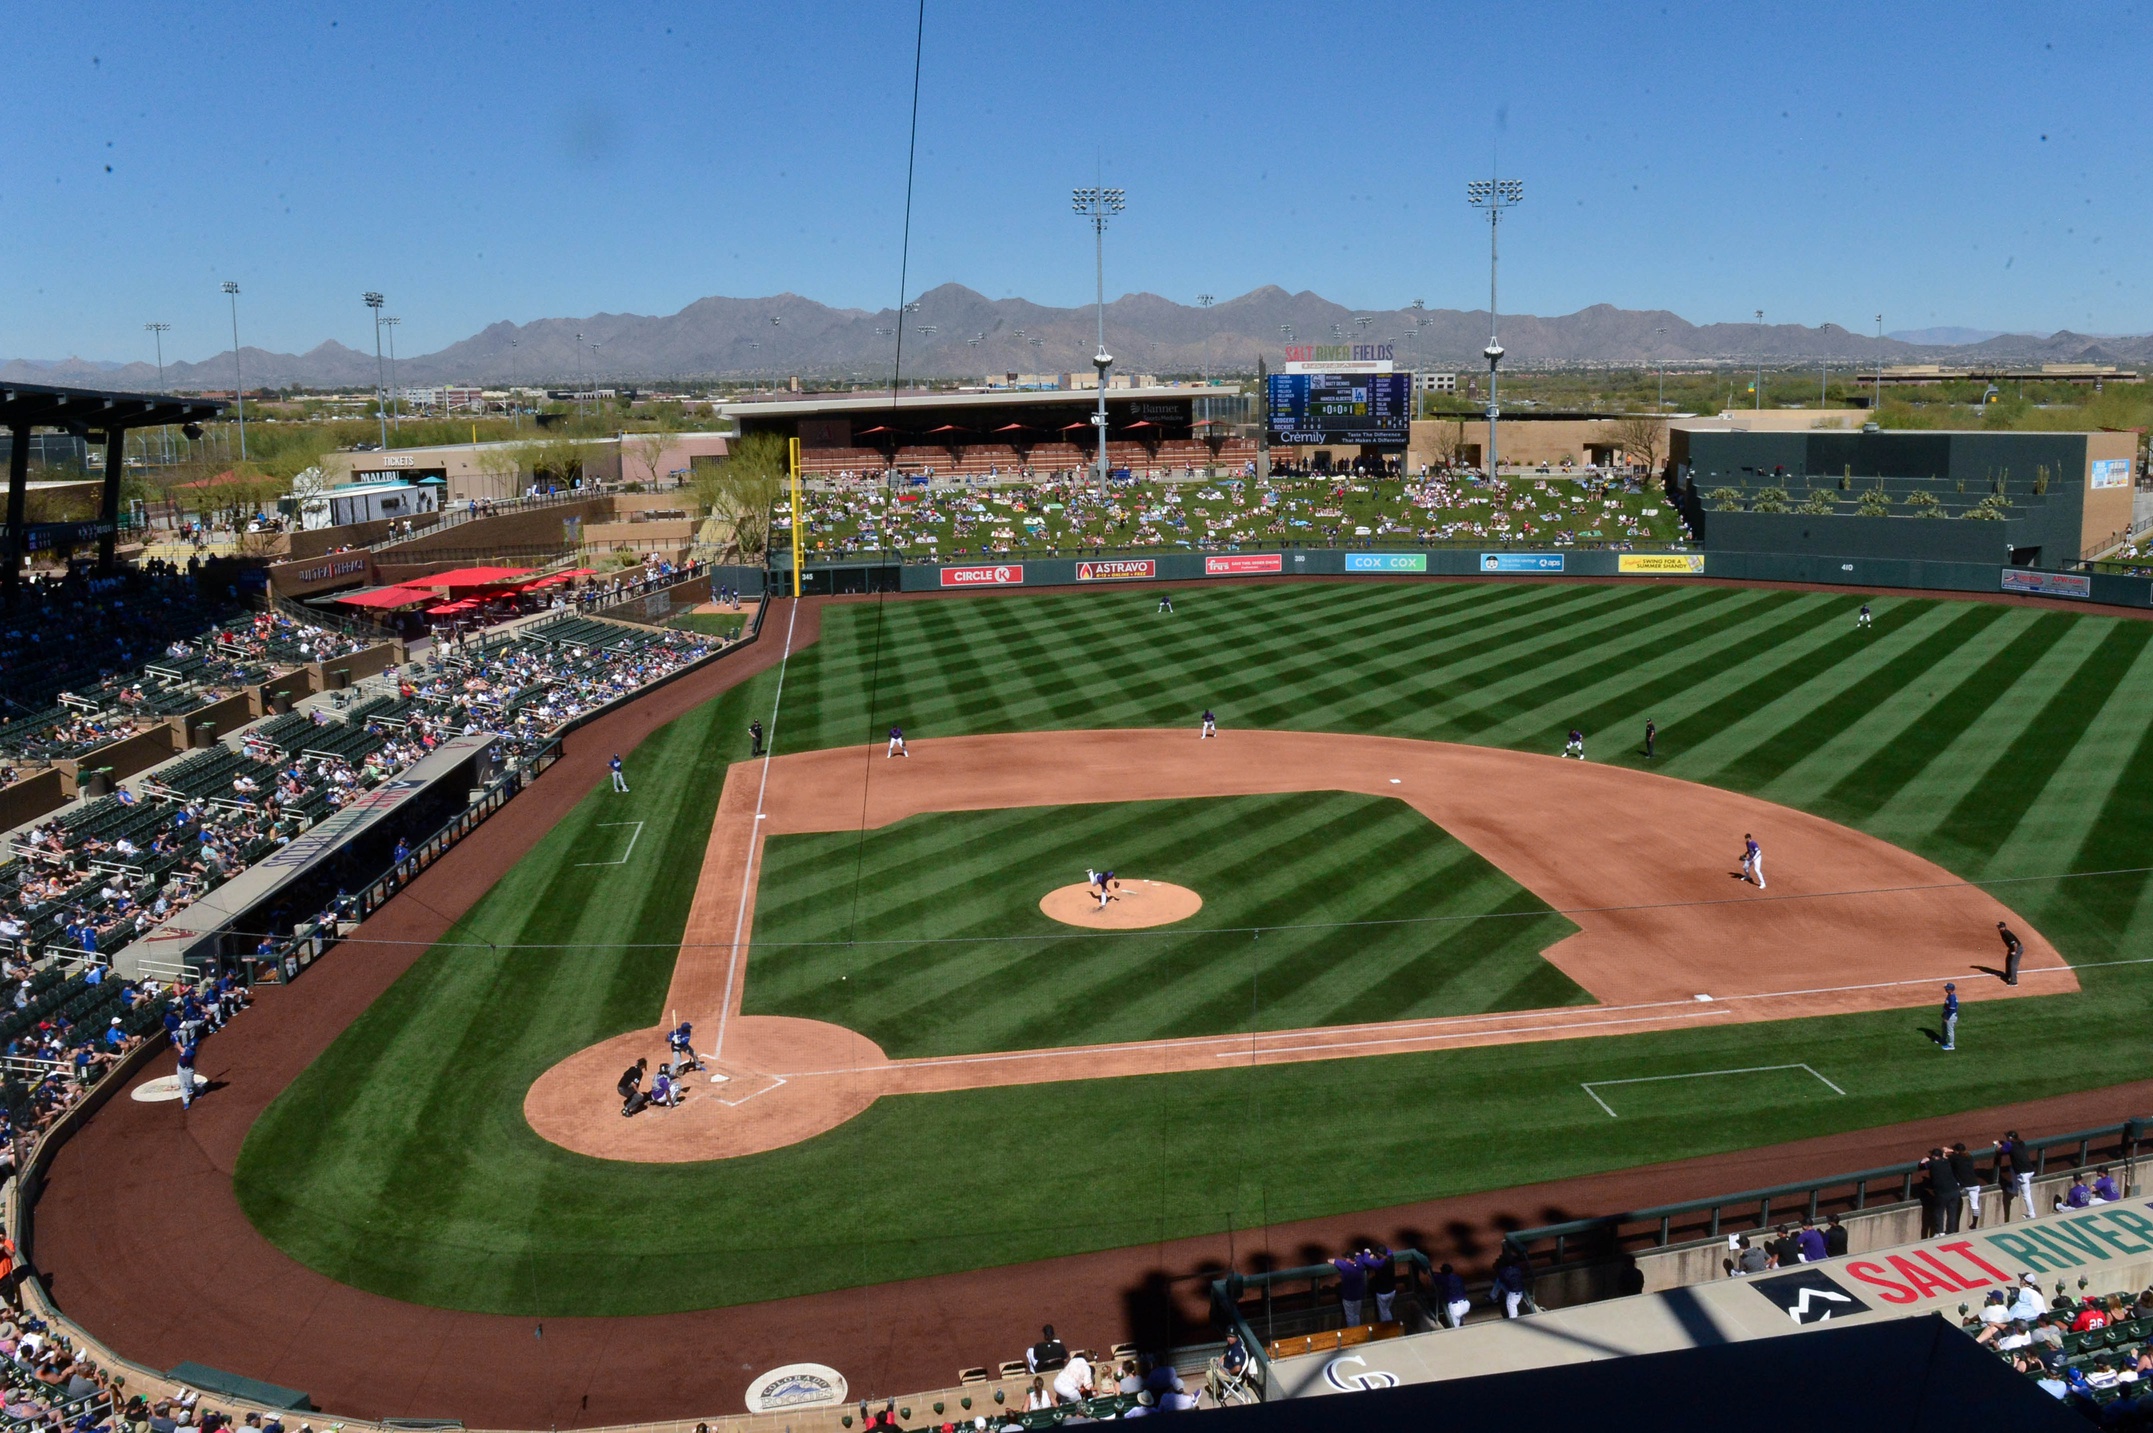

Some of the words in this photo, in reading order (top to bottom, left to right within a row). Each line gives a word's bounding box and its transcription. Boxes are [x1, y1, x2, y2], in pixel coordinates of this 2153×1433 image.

[1285, 346, 1312, 362] SALT
[1316, 345, 1350, 360] RIVER
[1354, 345, 1393, 360] FIELDS
[1143, 404, 1179, 413] Banner
[1327, 405, 1332, 414] 0
[1338, 405, 1342, 414] 0
[383, 456, 414, 466] TICKETS
[360, 471, 399, 482] MALIBU
[1096, 562, 1148, 573] ASTRAVO
[1356, 558, 1381, 567] COX
[1390, 558, 1416, 567] COX
[954, 571, 992, 581] CIRCLE
[1846, 1241, 2013, 1304] SALT
[1984, 1209, 2153, 1274] RIVER
[2089, 1318, 2104, 1330] 26
[763, 1375, 828, 1394] COLORADO
[760, 1390, 834, 1408] ROCKIES
